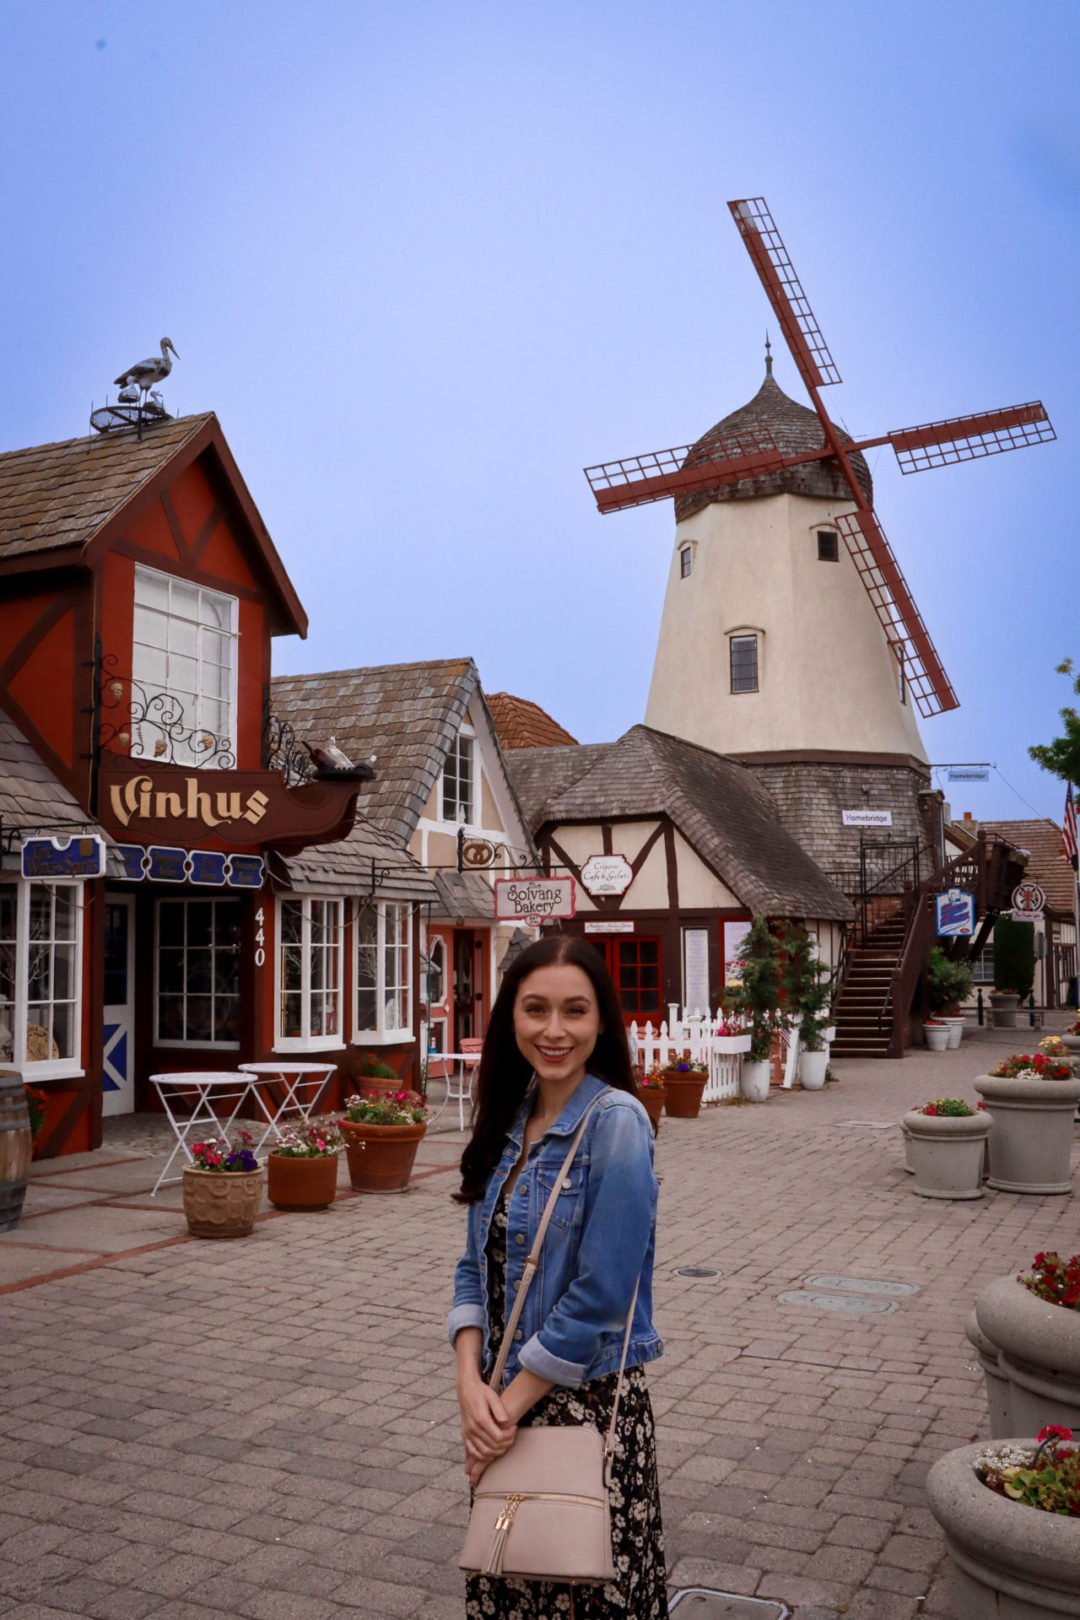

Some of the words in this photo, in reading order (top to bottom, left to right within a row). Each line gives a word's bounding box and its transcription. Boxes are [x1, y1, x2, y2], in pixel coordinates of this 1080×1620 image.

[950, 772, 986, 780] Homebridge
[110, 775, 270, 827] Vinhus
[846, 814, 888, 824] Homebridge
[529, 881, 542, 889] The
[507, 885, 562, 904] Solvang
[514, 900, 555, 916] Bakery
[254, 907, 266, 967] 440
